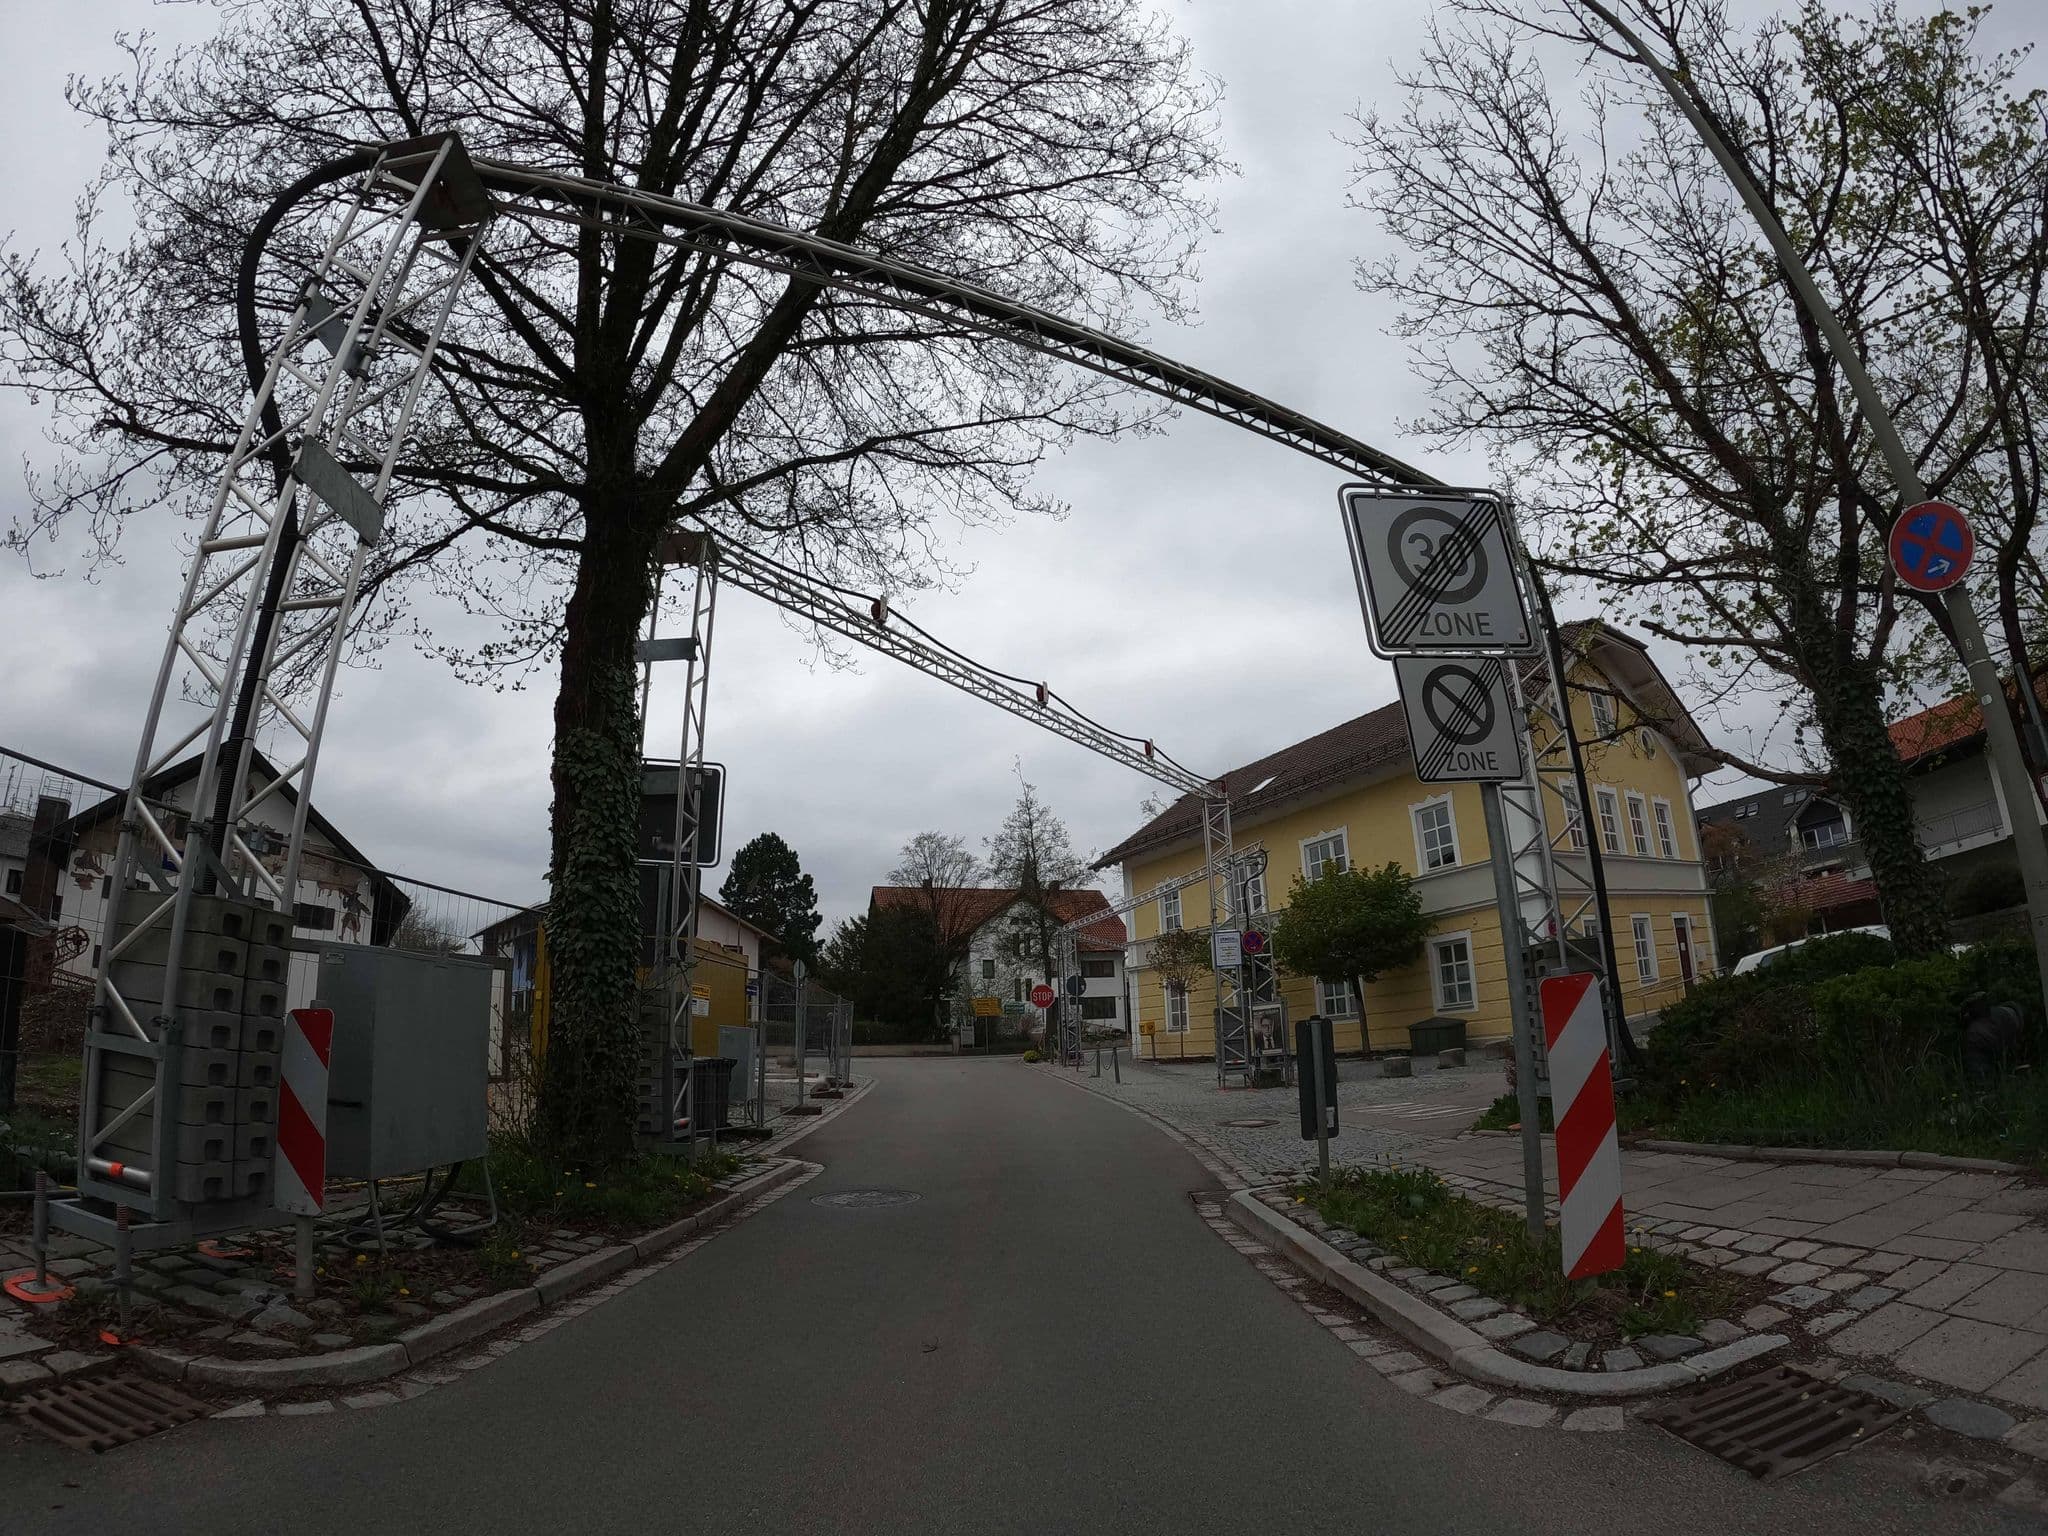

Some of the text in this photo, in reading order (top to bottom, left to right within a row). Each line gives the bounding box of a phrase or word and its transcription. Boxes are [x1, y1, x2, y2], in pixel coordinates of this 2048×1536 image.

[1408, 533, 1468, 576] 30
[1417, 612, 1493, 636] ZONE
[1444, 751, 1499, 772] ZONE
[1032, 991, 1052, 1002] STOP
